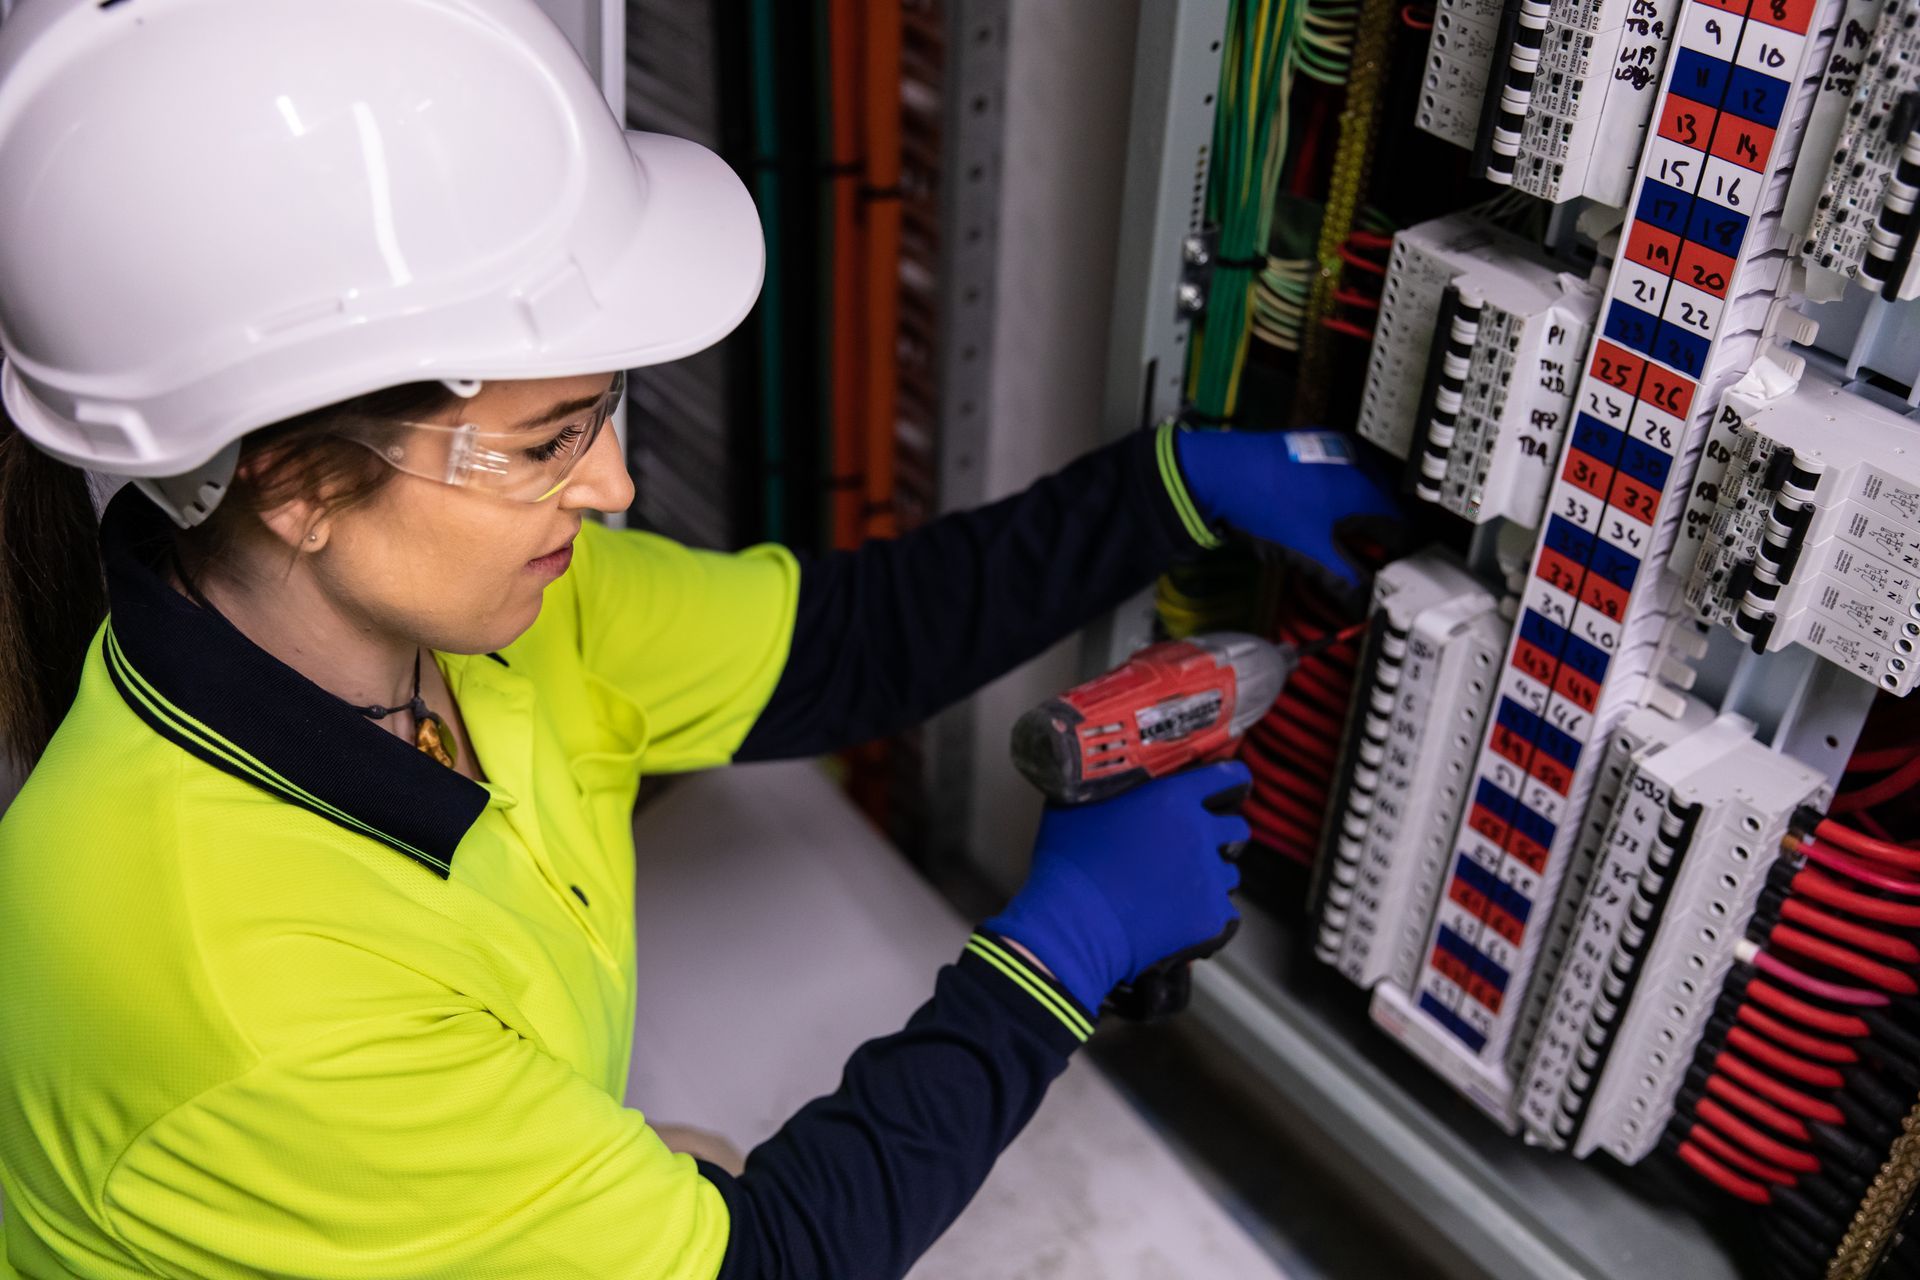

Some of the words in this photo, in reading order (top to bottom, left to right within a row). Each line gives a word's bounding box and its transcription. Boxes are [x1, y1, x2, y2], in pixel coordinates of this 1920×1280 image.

[1705, 19, 1722, 45] 9
[1759, 43, 1786, 68] 10
[1696, 67, 1710, 88] 11
[1743, 88, 1767, 114] 12
[1677, 114, 1697, 144] 13
[1736, 133, 1758, 162] 14
[1660, 159, 1690, 188] 15
[1716, 175, 1742, 206] 16
[1653, 200, 1678, 222] 17
[1703, 218, 1741, 246] 18
[1646, 243, 1669, 266] 19
[1692, 264, 1725, 291] 20
[1632, 279, 1656, 303] 21
[1681, 302, 1710, 331] 22
[1618, 319, 1646, 344] 23
[1600, 357, 1632, 388] 25
[1654, 382, 1683, 411] 26
[1590, 392, 1622, 419] 27
[1645, 418, 1672, 449] 28
[1573, 460, 1598, 489] 31
[1624, 485, 1655, 520] 32
[1565, 497, 1589, 525] 33
[1611, 521, 1641, 549] 34
[1902, 554, 1913, 564] N
[1551, 563, 1574, 591] 37
[1594, 588, 1619, 618] 38
[1887, 591, 1897, 600] N
[1542, 592, 1566, 626] 39
[1586, 621, 1614, 649] 40
[1873, 627, 1882, 636] N
[1859, 662, 1868, 671] N
[1515, 678, 1543, 714] 45
[1553, 702, 1583, 732] 46
